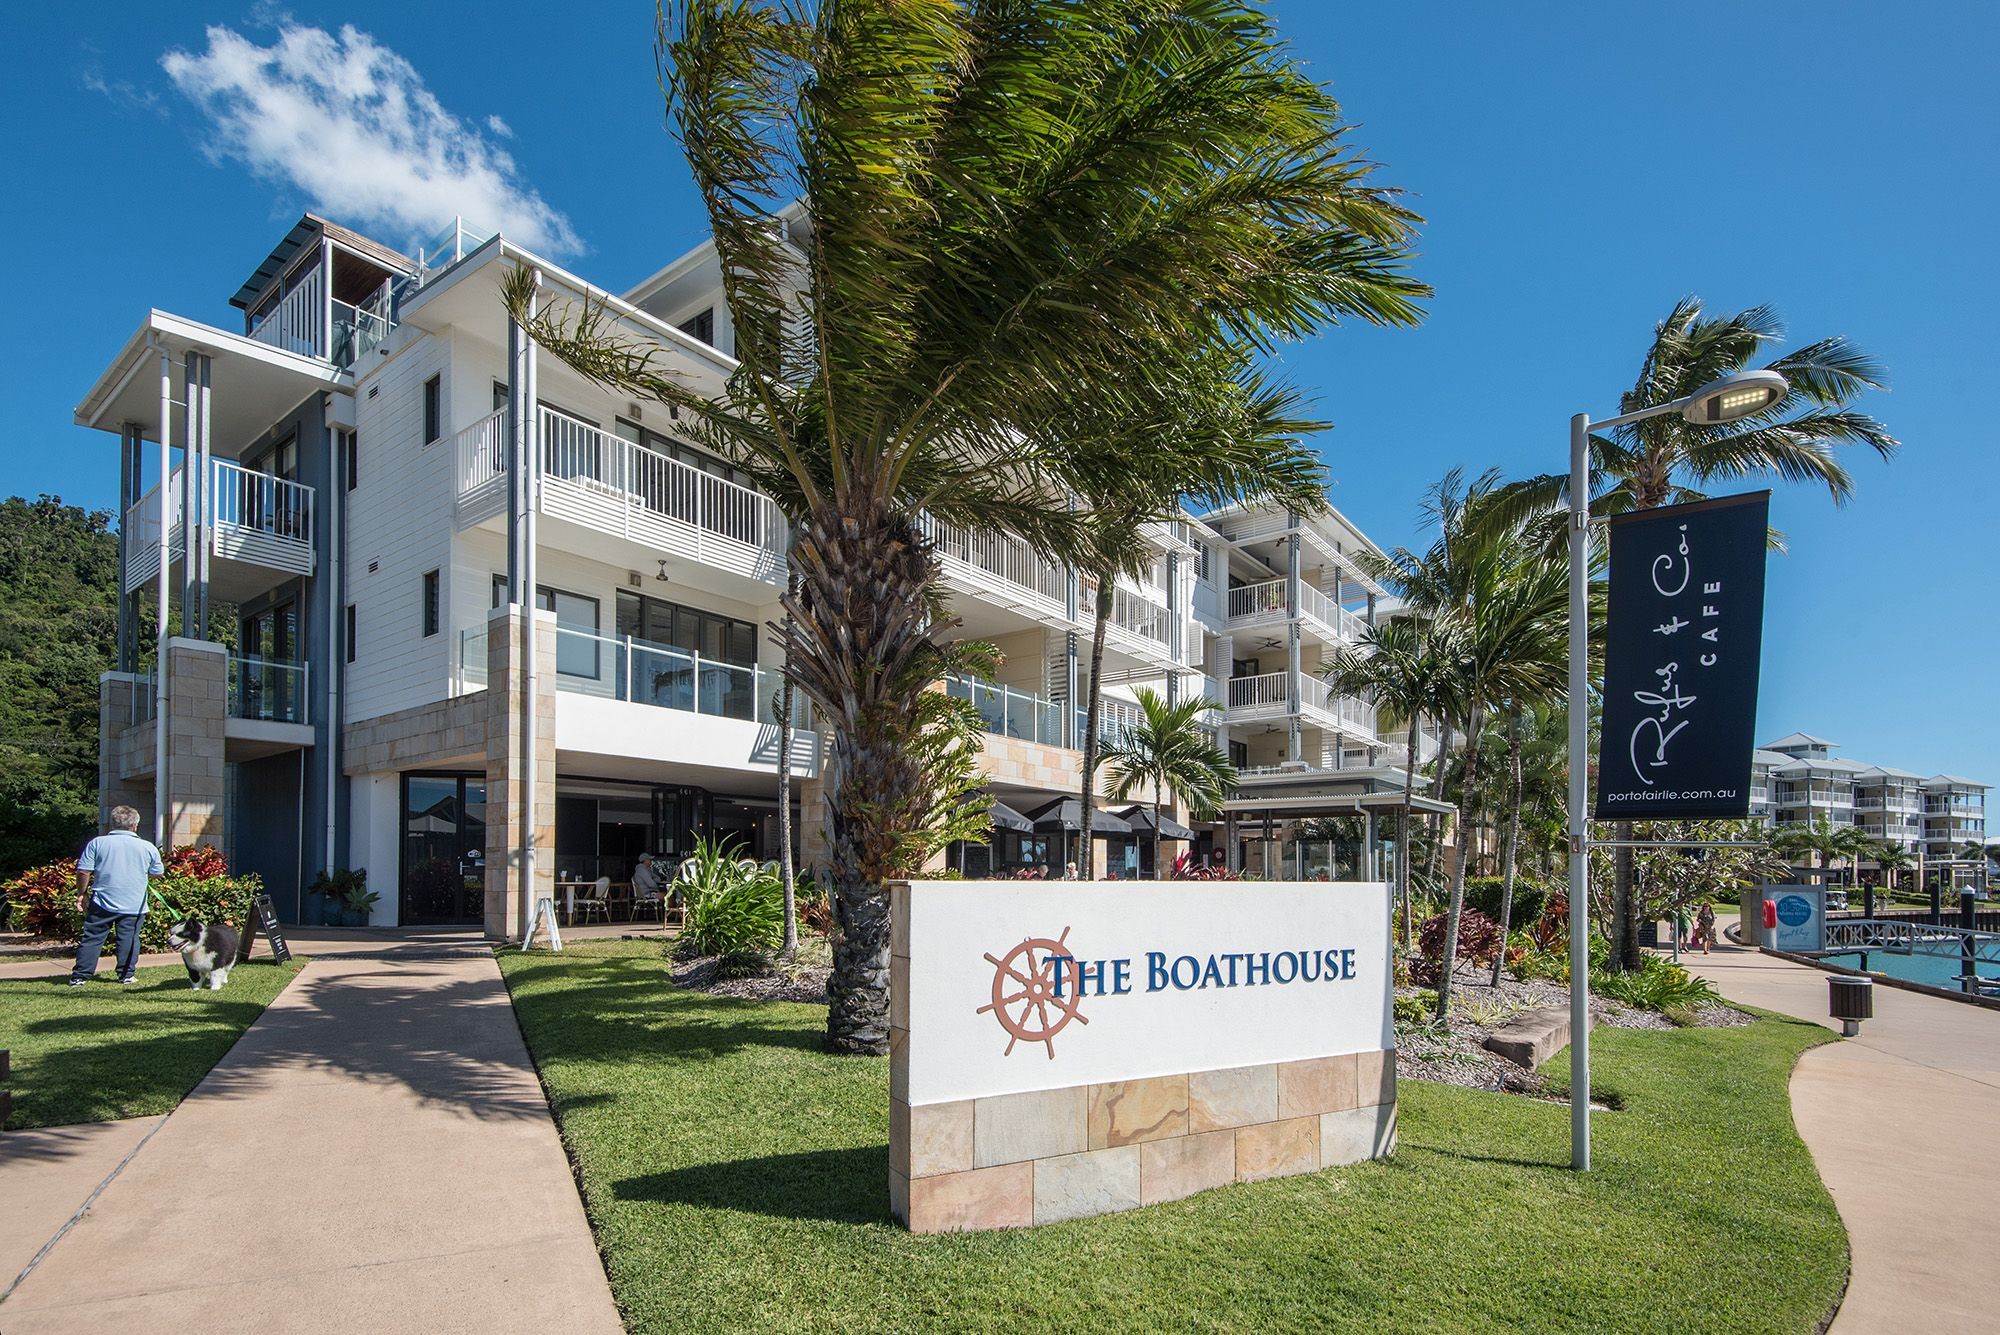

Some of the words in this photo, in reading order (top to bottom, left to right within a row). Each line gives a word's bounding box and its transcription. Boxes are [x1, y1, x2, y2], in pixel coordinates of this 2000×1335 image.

[1653, 616, 1690, 636] &
[1700, 581, 1721, 666] CAFE
[1630, 662, 1697, 785] Rufus
[1607, 789, 1736, 803] portofairlie.com.au
[1042, 955, 1133, 998] THE
[1144, 948, 1357, 993] BOATHOUSE
